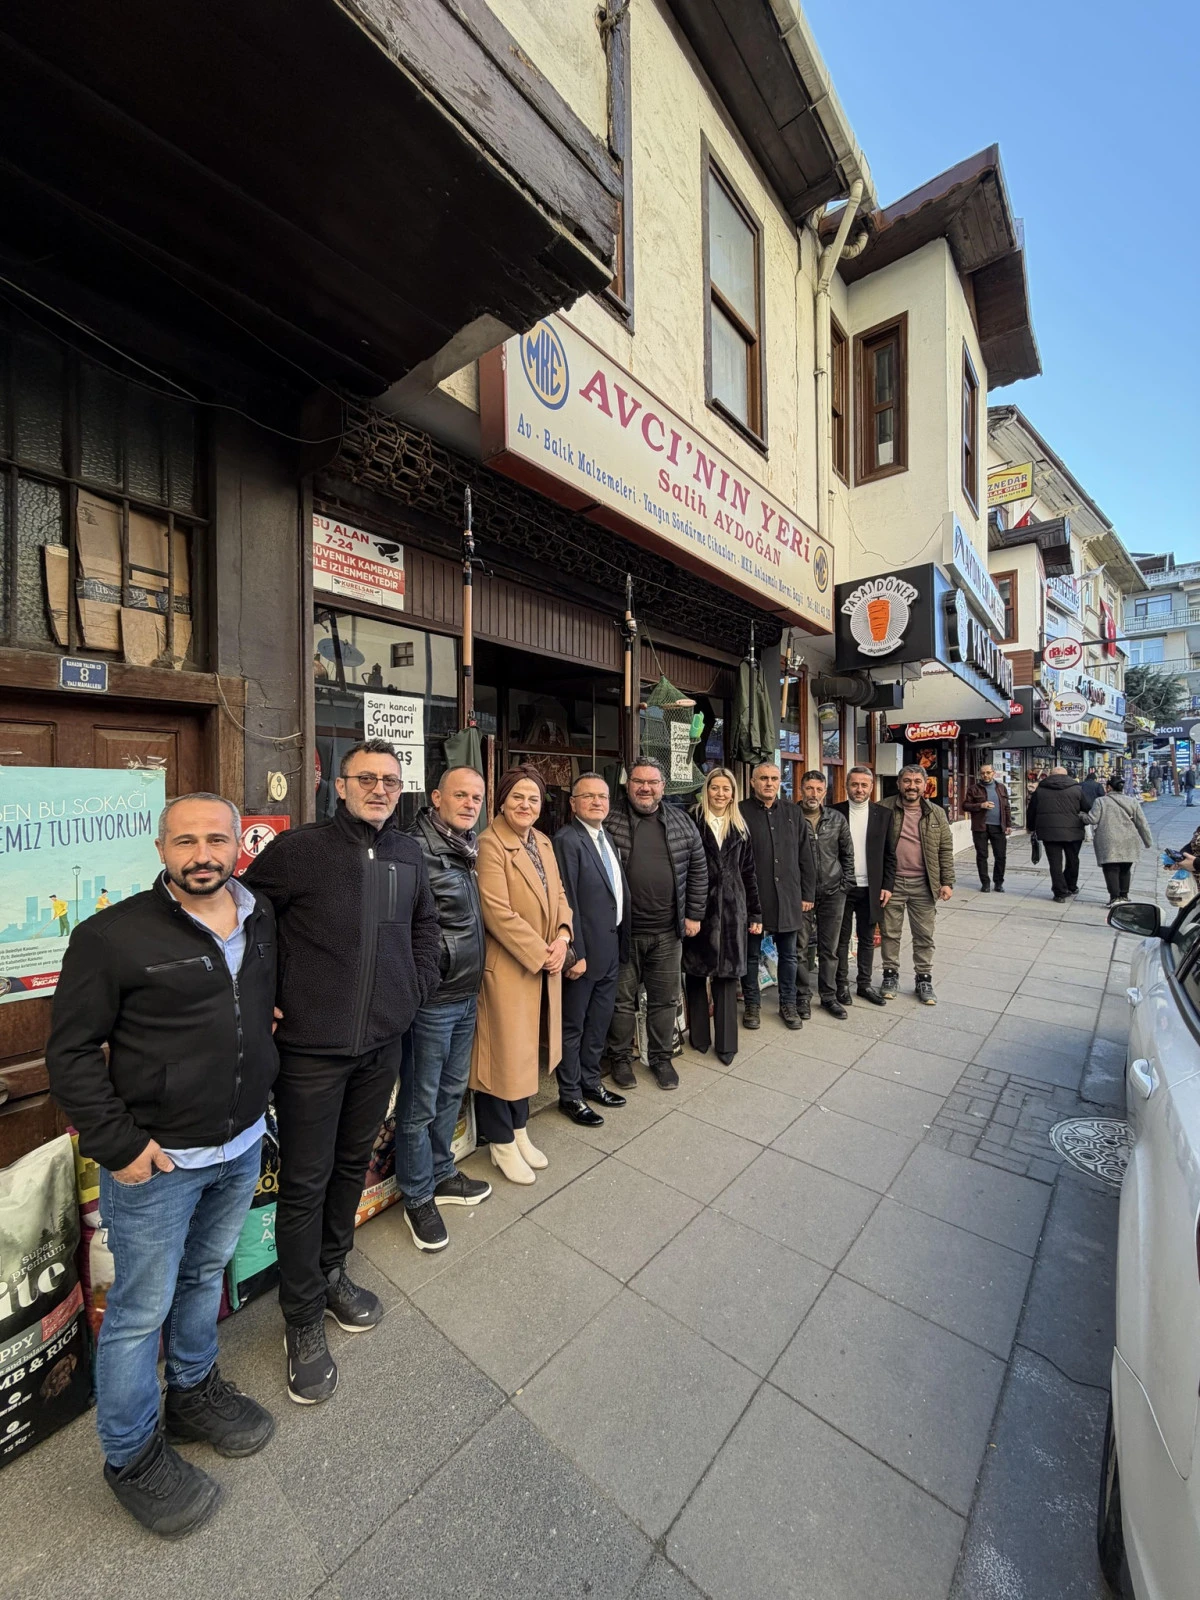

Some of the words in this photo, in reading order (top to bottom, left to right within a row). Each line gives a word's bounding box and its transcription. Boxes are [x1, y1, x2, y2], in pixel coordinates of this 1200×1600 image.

[517, 413, 532, 438] Av
[544, 429, 574, 466] Balık
[578, 451, 637, 504] Malzemeleri
[643, 493, 670, 524] Yangın
[672, 512, 706, 546] Söndürme
[658, 469, 708, 519] Salih
[714, 510, 781, 567] AYDOĞAN
[325, 534, 354, 551] 7-24
[333, 525, 369, 544] ALAN
[358, 560, 402, 580] KAMERASI
[843, 583, 873, 613] PASAJ
[876, 579, 916, 604] DÖNER
[80, 668, 89, 682] 8
[367, 700, 386, 709] Sarı
[389, 702, 417, 712] kancalı
[372, 710, 413, 726] Çapari
[367, 724, 414, 738] Bulunur
[408, 781, 422, 790] TL
[40, 800, 66, 819] BU
[72, 790, 147, 816] SOKAĞI
[47, 810, 152, 848] TUTUYORUM
[11, 1243, 66, 1282] premium
[22, 1240, 54, 1264] super
[29, 1357, 44, 1373] &
[46, 1321, 78, 1360] RICE
